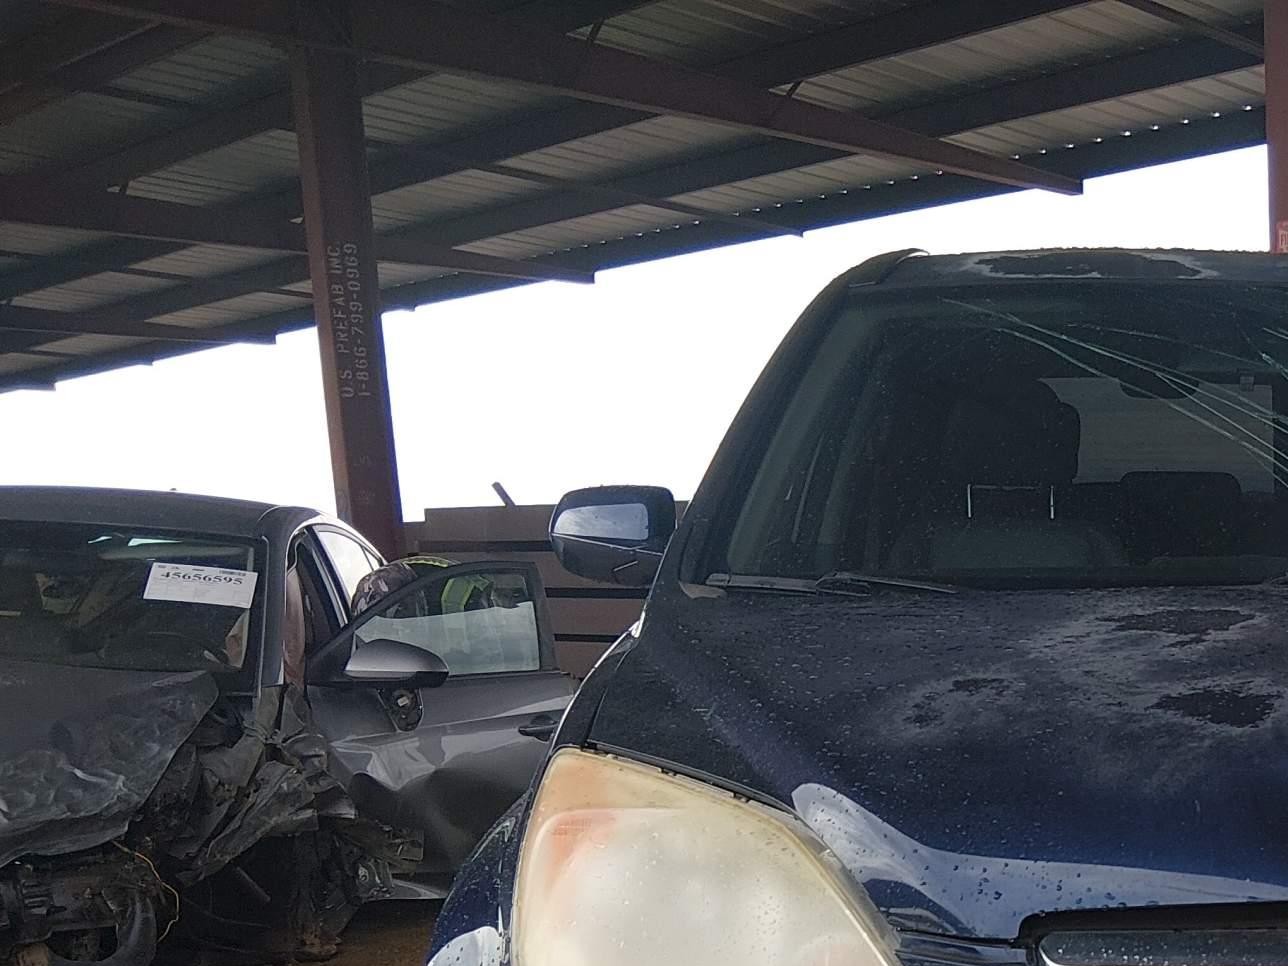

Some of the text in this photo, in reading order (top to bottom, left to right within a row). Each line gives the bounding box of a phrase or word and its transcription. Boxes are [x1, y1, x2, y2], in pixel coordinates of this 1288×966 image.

[330, 283, 349, 353] PREFAB
[343, 243, 371, 397] 1-866-799-0969
[160, 571, 243, 585] 45656595
